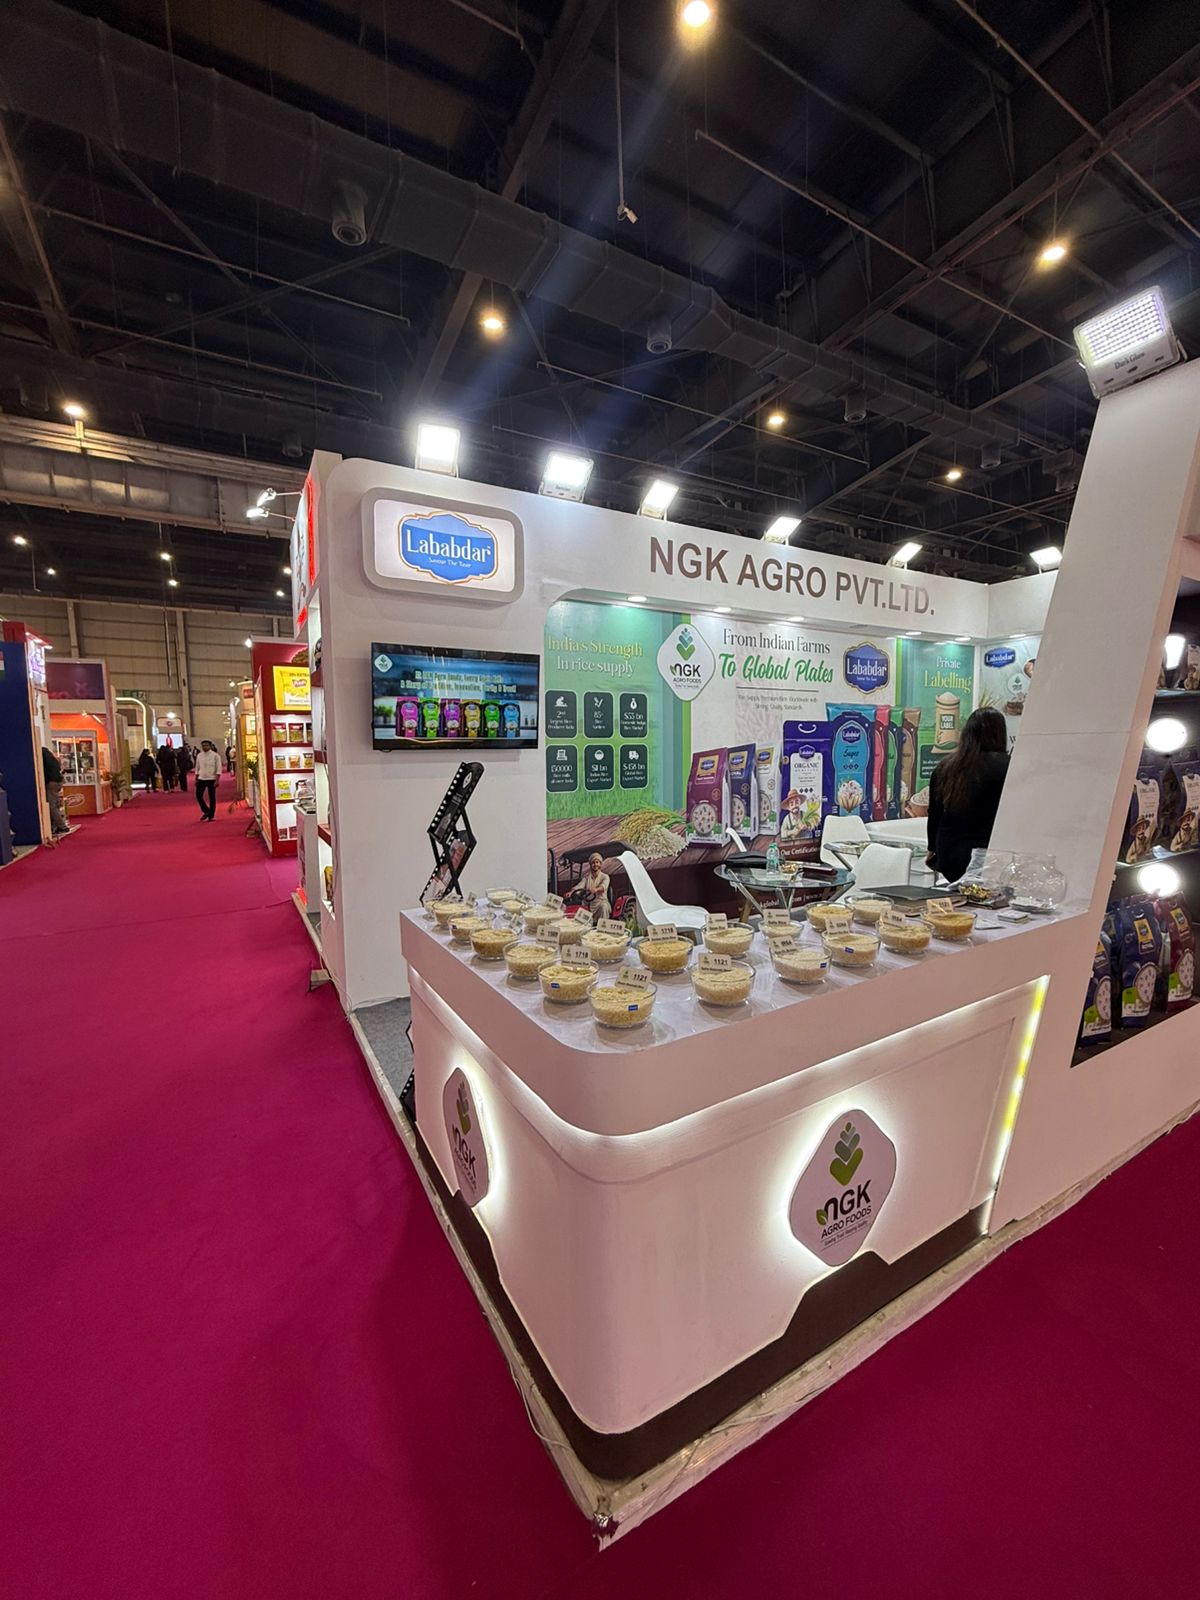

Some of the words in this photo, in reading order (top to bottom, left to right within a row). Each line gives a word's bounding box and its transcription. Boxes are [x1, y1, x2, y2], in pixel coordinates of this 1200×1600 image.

[406, 529, 491, 563] Lababdar
[650, 536, 729, 584] NGK
[736, 554, 827, 598] AGRO
[590, 639, 644, 659] Strength
[723, 628, 757, 648] From
[759, 632, 795, 651] Indian
[796, 635, 831, 654] Farms
[557, 655, 569, 670] In
[571, 657, 595, 672] rice
[596, 660, 634, 678] supply
[719, 653, 737, 680] To
[742, 653, 791, 682] Global
[794, 659, 834, 684] Plates
[847, 658, 887, 677] Lababdar
[936, 655, 961, 670] Private
[924, 670, 972, 693] Labelling
[575, 951, 589, 959] 1718
[633, 973, 647, 981] 1121
[820, 1218, 845, 1240] AGRO
[845, 1205, 872, 1227] FOODS
